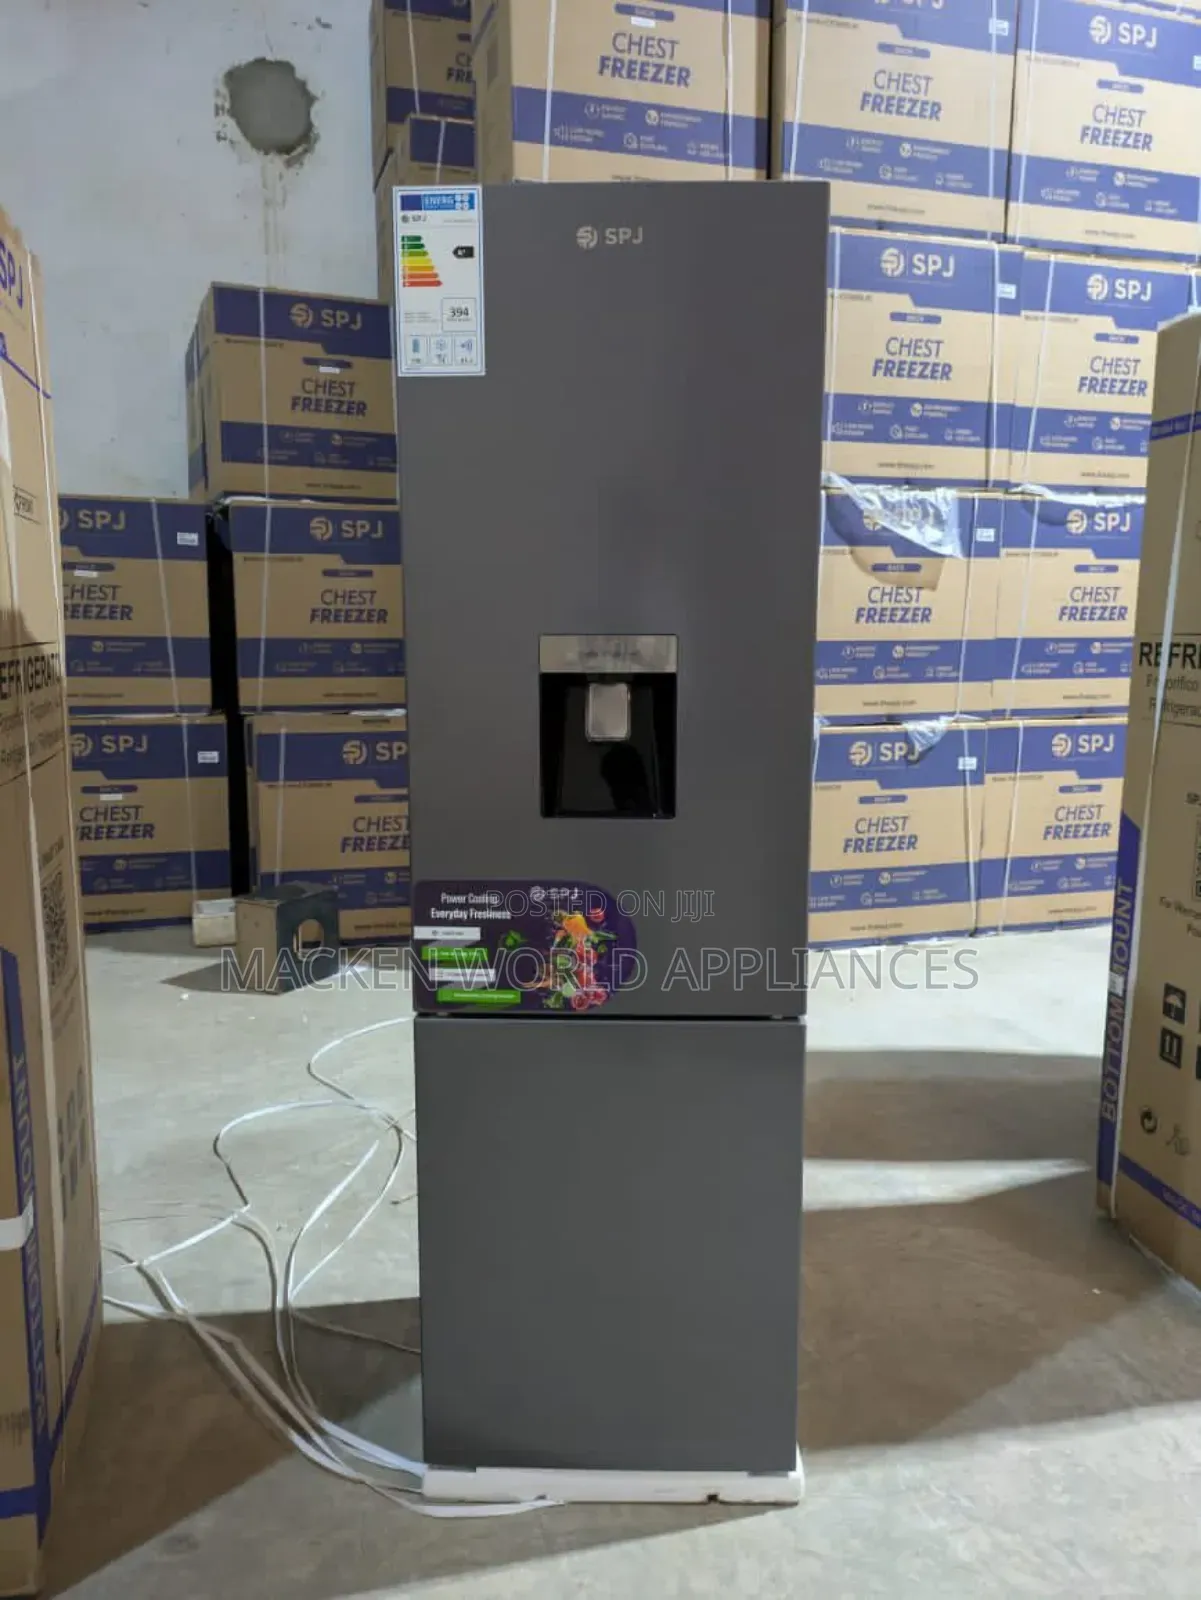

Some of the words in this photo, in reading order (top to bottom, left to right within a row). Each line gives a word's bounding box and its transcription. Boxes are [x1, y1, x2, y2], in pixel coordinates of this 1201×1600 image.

[1118, 23, 1157, 49] SPJ
[612, 32, 680, 61] CHEST
[598, 55, 691, 88] FREEZER
[873, 68, 934, 97] CHEST
[859, 93, 942, 122] FREEZER
[1092, 103, 1146, 128] CHEST
[1080, 125, 1154, 152] FREEZER
[605, 226, 643, 245] SPJ
[912, 253, 955, 278] SPJ
[1114, 278, 1152, 301] SPJ
[321, 309, 363, 330] SPJ
[450, 305, 470, 318] 394
[885, 336, 944, 358] CHEST
[872, 359, 953, 381] FREEZER
[1090, 355, 1141, 376] CHEST
[302, 377, 356, 398] CHEST
[1077, 376, 1148, 397] FREEZER
[290, 396, 368, 418] FREEZER
[78, 509, 126, 531] SPJ
[341, 520, 384, 539] SPJ
[1093, 512, 1131, 533] SPJ
[320, 588, 377, 606] CHEST
[867, 586, 924, 605] CHEST
[1069, 586, 1121, 603] CHEST
[63, 603, 133, 621] REEZER
[309, 608, 388, 625] FREEZER
[855, 607, 932, 624] FREEZER
[1058, 605, 1128, 621] FREEZER
[101, 734, 148, 753] SPJ
[375, 742, 408, 761] SP
[879, 742, 919, 762] SPJ
[1077, 733, 1115, 753] SPJ
[79, 805, 144, 822] CHEST
[1054, 804, 1105, 822] CHEST
[77, 823, 155, 841] REEZER
[855, 815, 910, 834] CHEST
[1043, 822, 1112, 841] FREEZER
[340, 836, 410, 853] FREEZE
[843, 834, 918, 853] FREEZER
[441, 892, 466, 904] Power
[430, 907, 468, 920] Everyday
[1102, 996, 1124, 1123] BOTTOM
